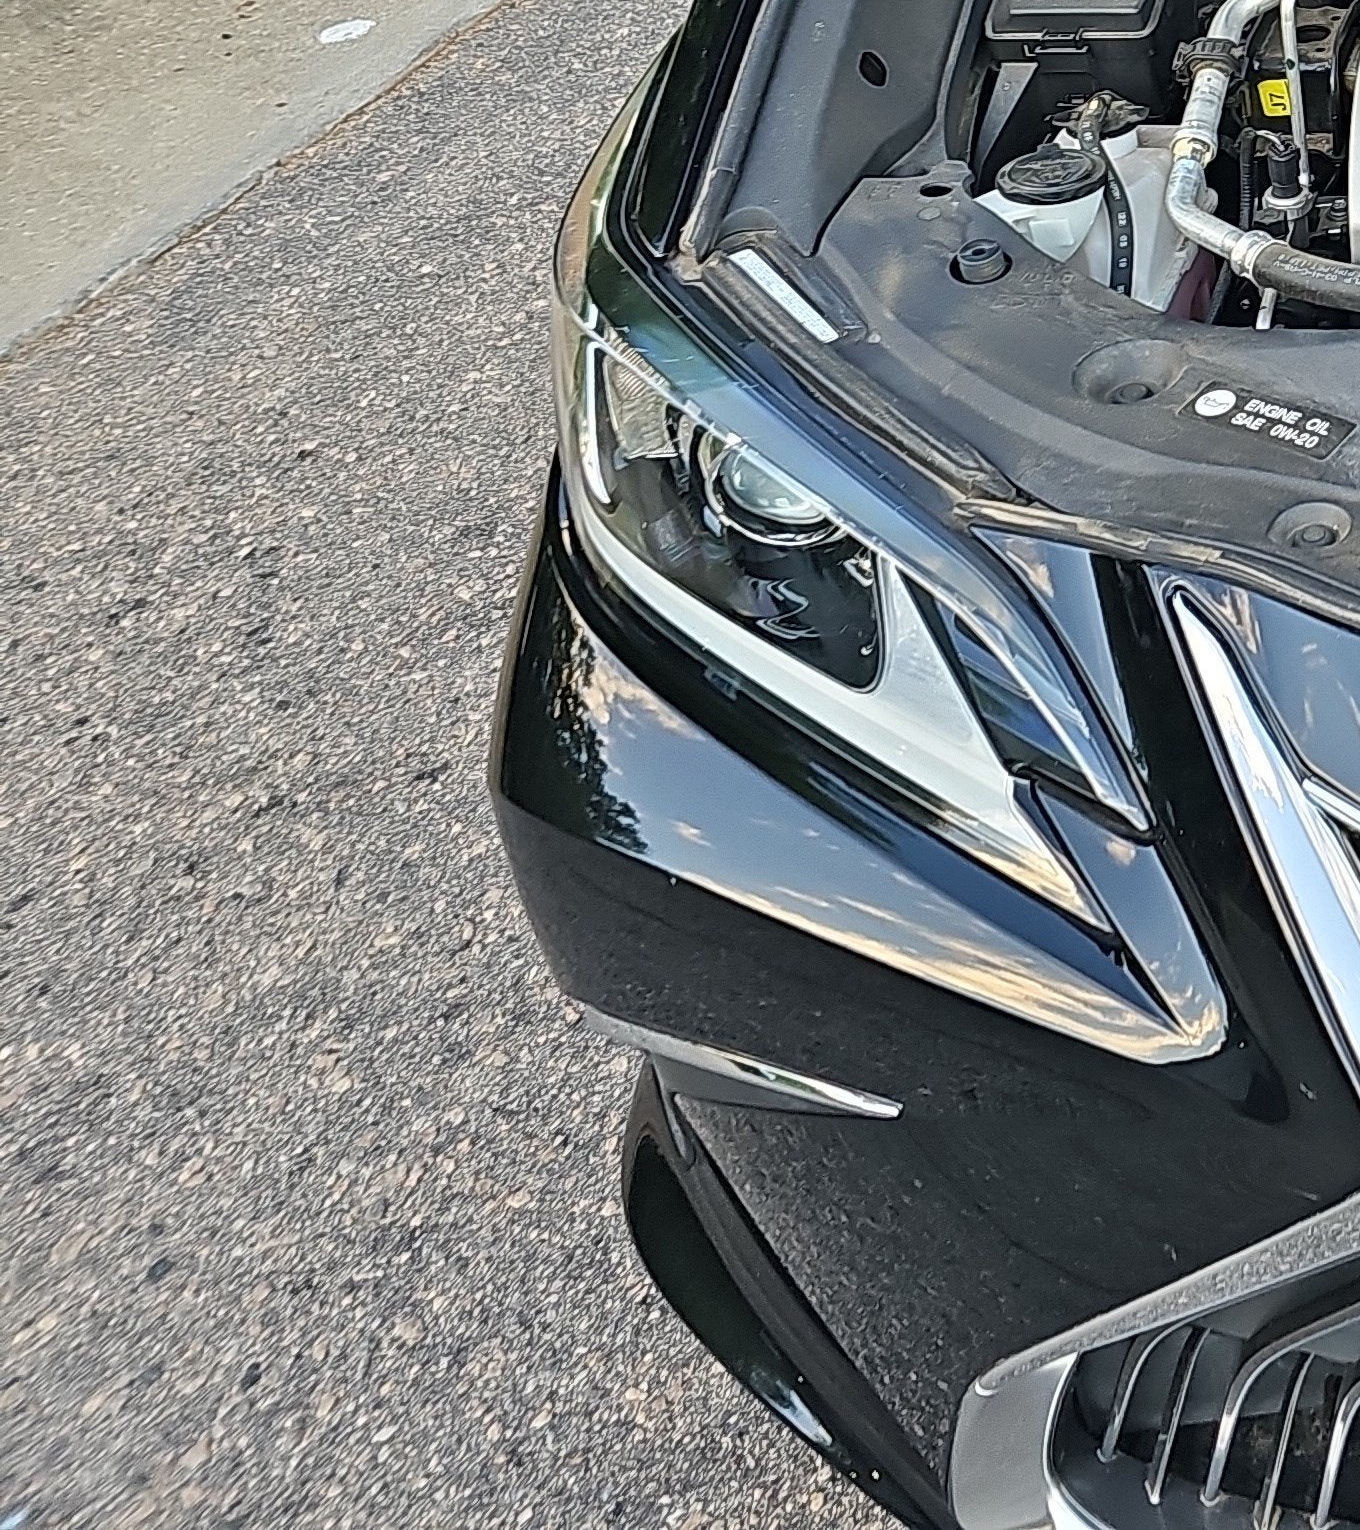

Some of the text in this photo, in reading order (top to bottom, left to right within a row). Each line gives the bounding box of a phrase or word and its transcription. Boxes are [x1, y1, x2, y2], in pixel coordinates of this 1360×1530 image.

[1268, 92, 1287, 112] J7
[1230, 412, 1320, 449] SAE 0W-20
[1243, 398, 1332, 436] ENGINE OIL
